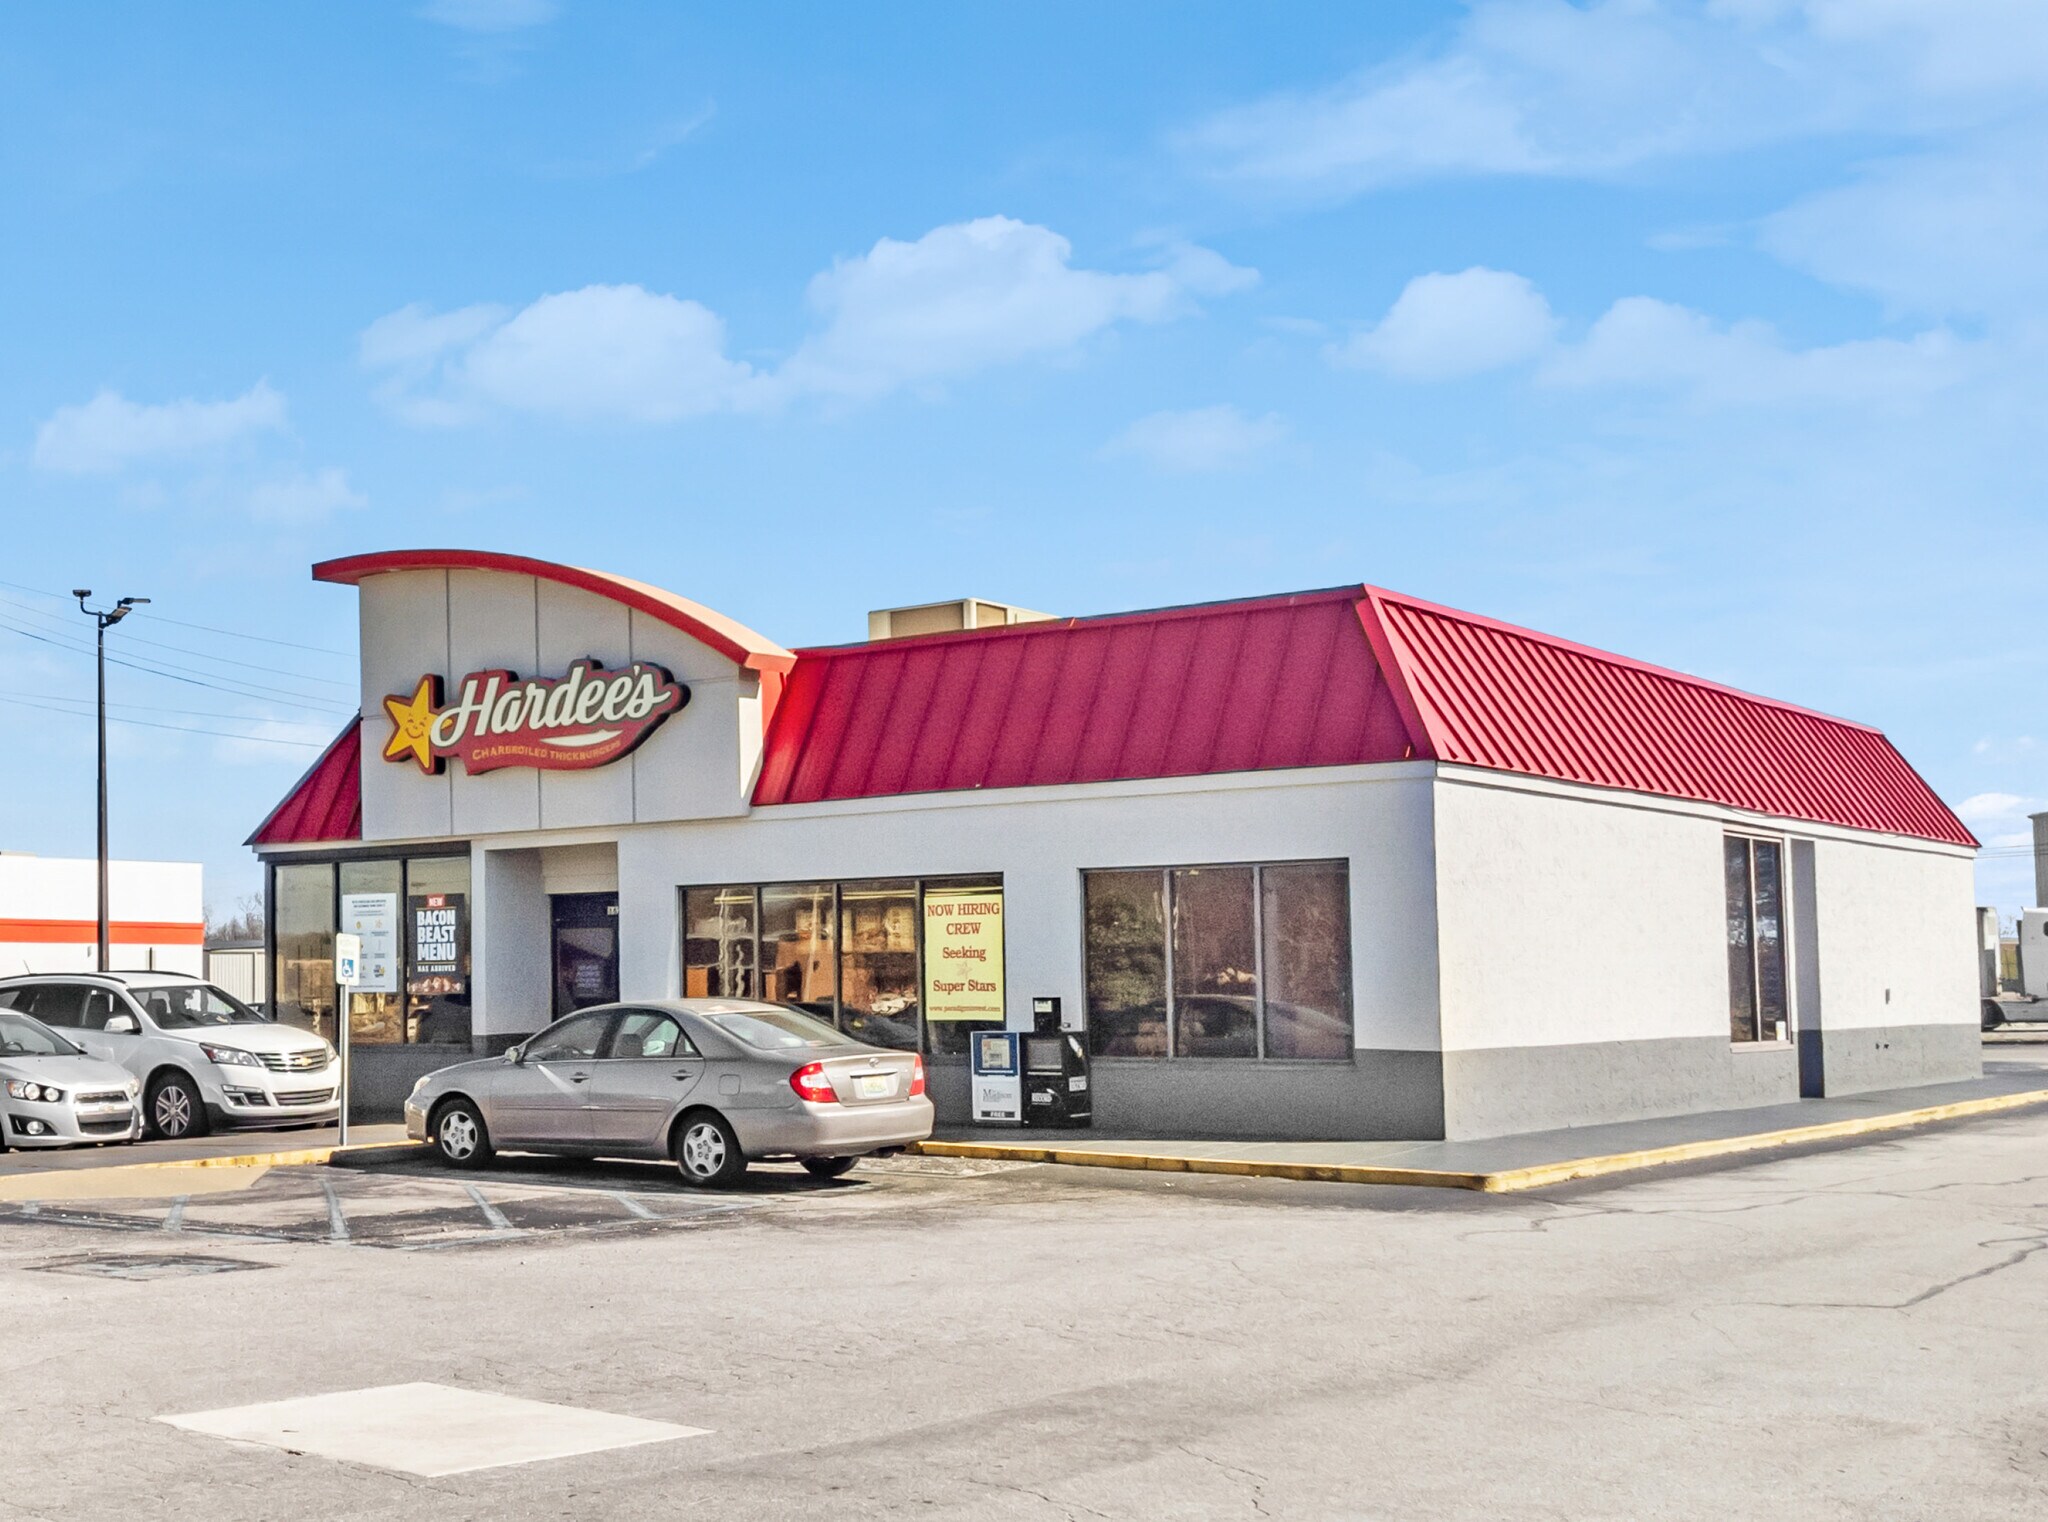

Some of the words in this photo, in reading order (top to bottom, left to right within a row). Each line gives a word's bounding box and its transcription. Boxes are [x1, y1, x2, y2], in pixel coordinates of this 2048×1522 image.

[430, 665, 671, 748] Hardee's
[472, 745, 547, 760] CHARBROILED
[550, 740, 622, 761] THICKBURGERS
[428, 897, 444, 907] NEW
[927, 904, 955, 917] NOW
[957, 902, 1001, 916] HIRING
[416, 909, 456, 926] BACON
[417, 925, 456, 943] BEAST
[946, 922, 982, 935] CREW
[417, 942, 456, 961] MENU
[942, 945, 987, 962] Seeking
[417, 964, 429, 973] HAS
[430, 964, 456, 973] ARRIVED
[933, 979, 966, 995] Super
[968, 978, 997, 992] Stars
